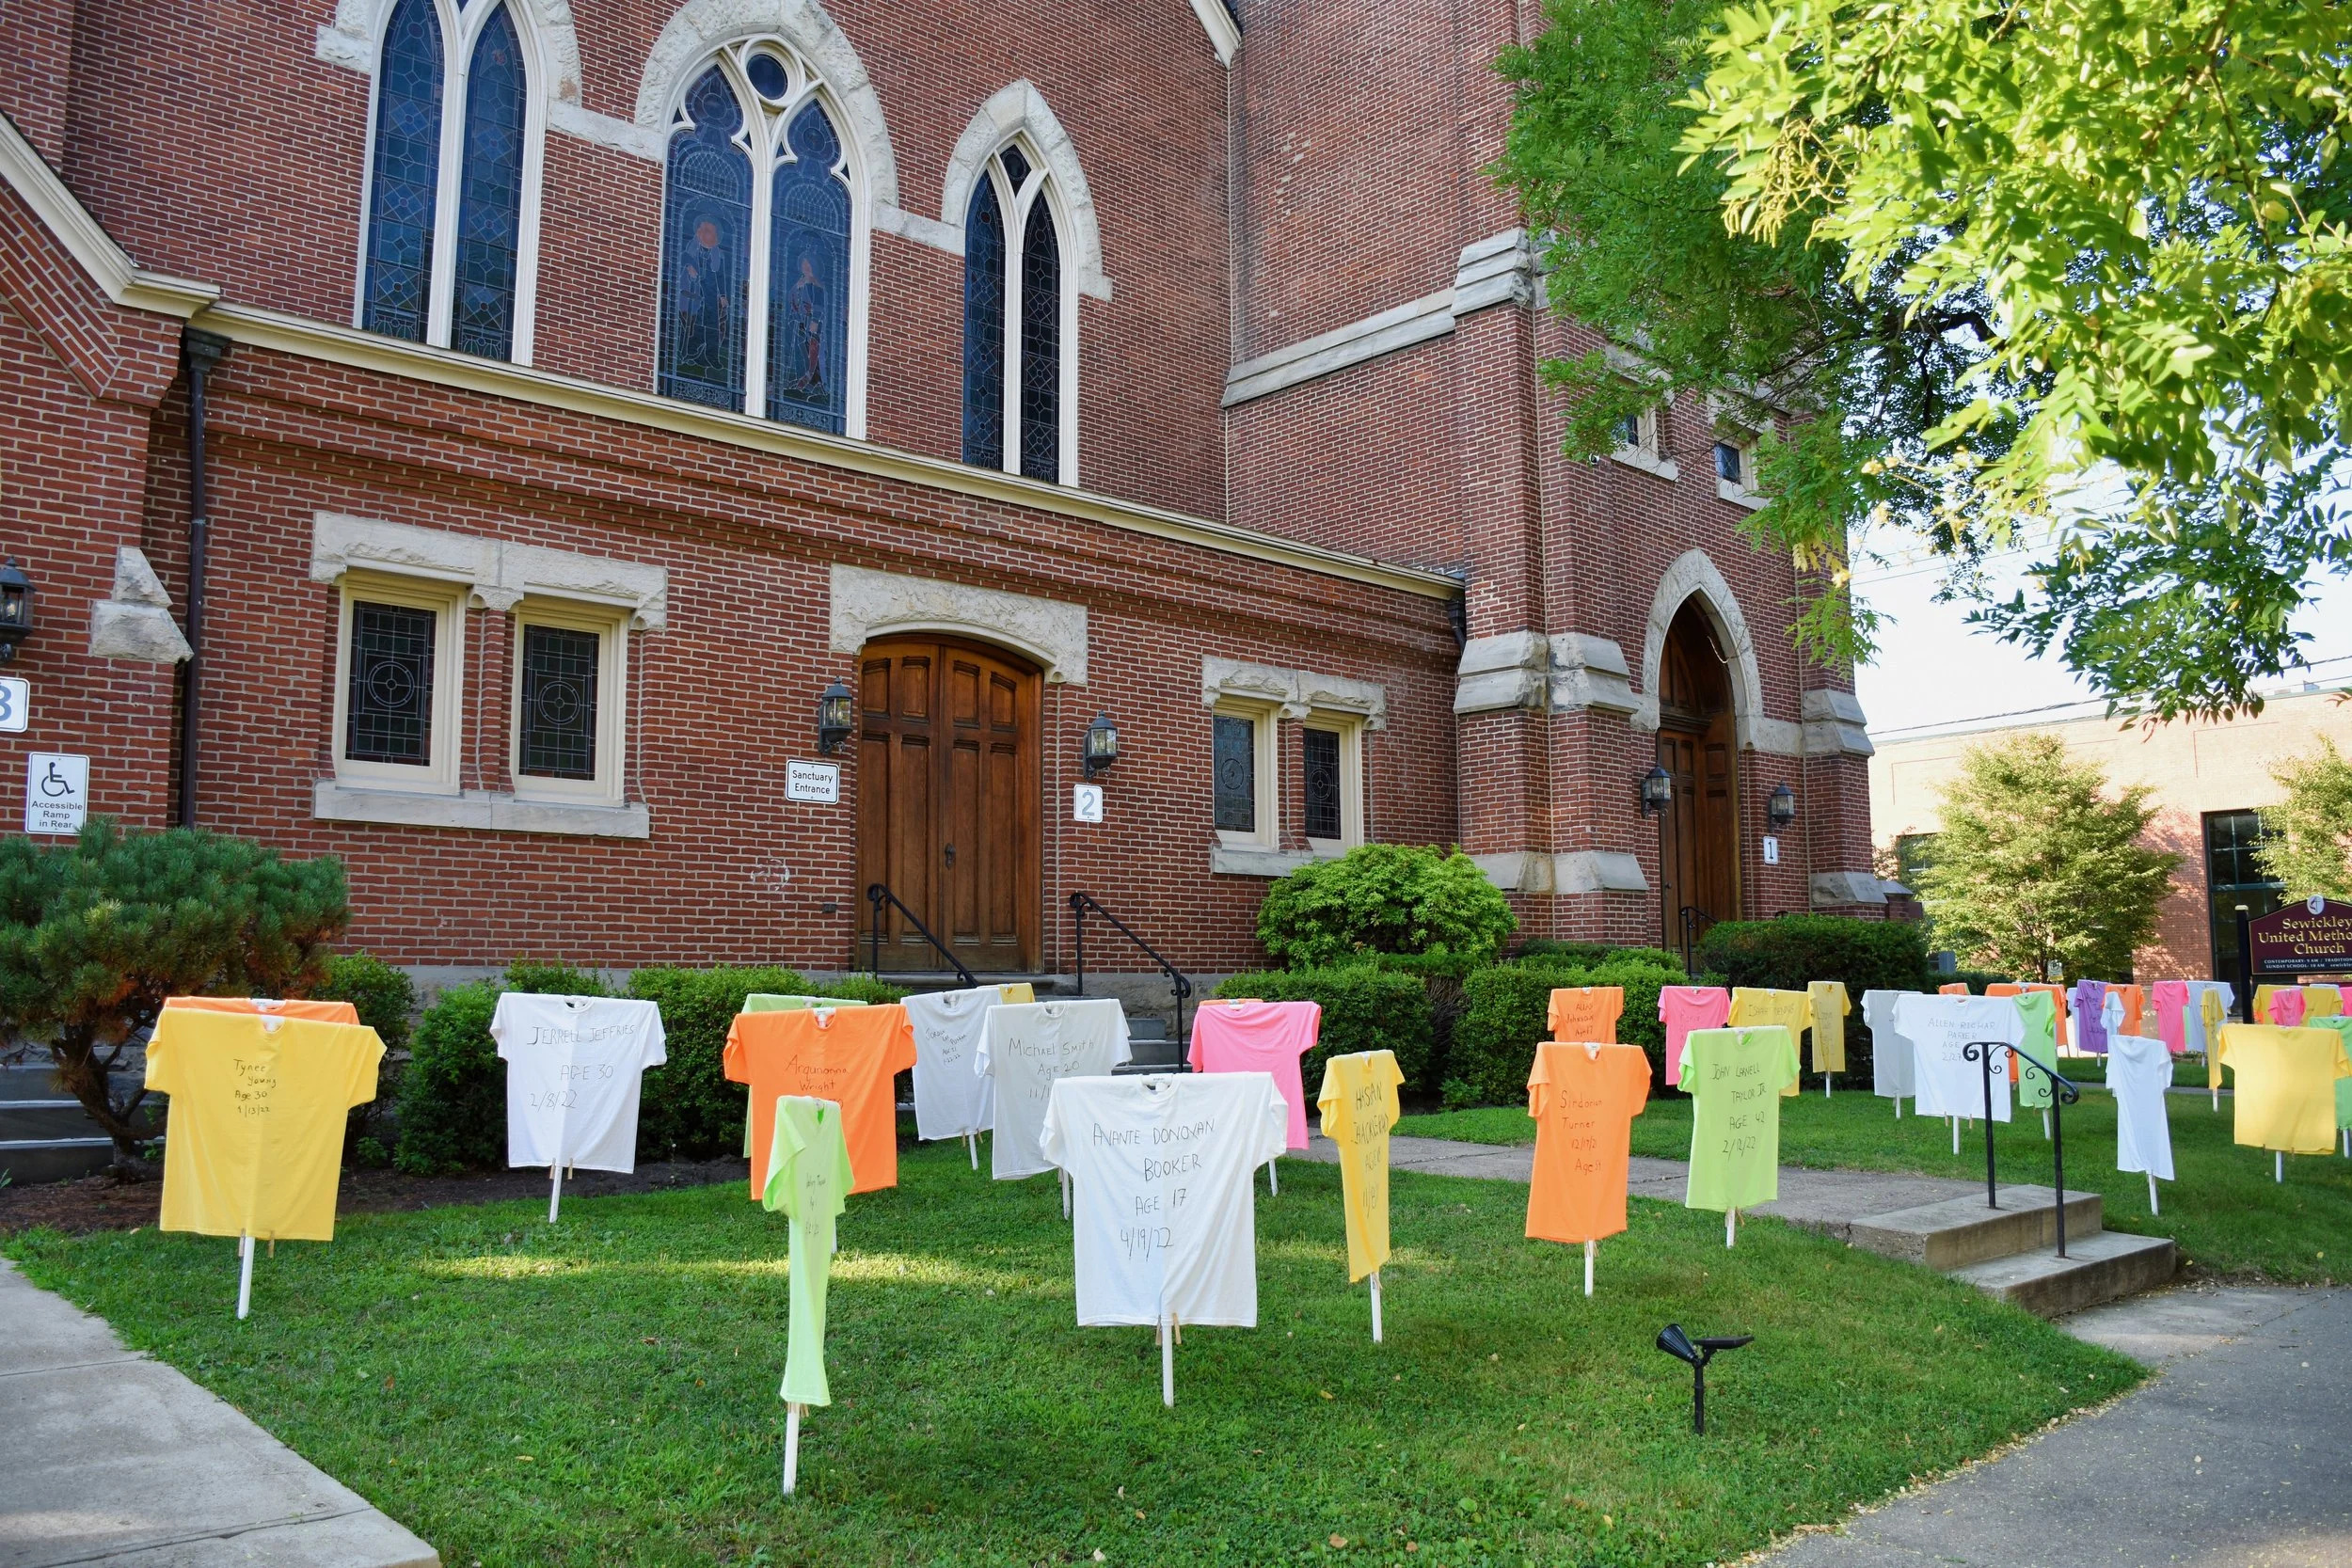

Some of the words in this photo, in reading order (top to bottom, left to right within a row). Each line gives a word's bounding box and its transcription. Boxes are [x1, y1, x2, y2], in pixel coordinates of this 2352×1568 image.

[792, 769, 834, 784] Sanctuary
[795, 783, 831, 795] Entrance
[31, 800, 83, 811] Accessible
[1081, 791, 1095, 816] 2
[42, 811, 71, 819] Ramp
[39, 819, 48, 828] in
[50, 820, 72, 829] Rear
[1767, 840, 1774, 860] 1
[2282, 916, 2352, 929] Sewickley
[2258, 931, 2304, 943] United
[2294, 942, 2345, 954] Church
[527, 1026, 580, 1045] JERRELL
[589, 1024, 635, 1042] JEFFRIES
[561, 1064, 589, 1081] AGE
[597, 1064, 614, 1079] 30
[1064, 1060, 1080, 1072] 20
[799, 1079, 835, 1093] Wright
[235, 1089, 251, 1101] Age
[254, 1090, 268, 1101] 30
[1731, 1088, 1755, 1103] TAYLOR
[1562, 1117, 1596, 1130] Turner
[1729, 1115, 1747, 1131] AGE
[1755, 1111, 1765, 1123] 42
[1092, 1122, 1141, 1147] AVANTE
[1152, 1118, 1216, 1145] DONOVAN
[1144, 1153, 1202, 1181] BOOKER
[1574, 1158, 1593, 1176] Age
[1135, 1196, 1160, 1216] AGE
[1172, 1188, 1186, 1208] 17
